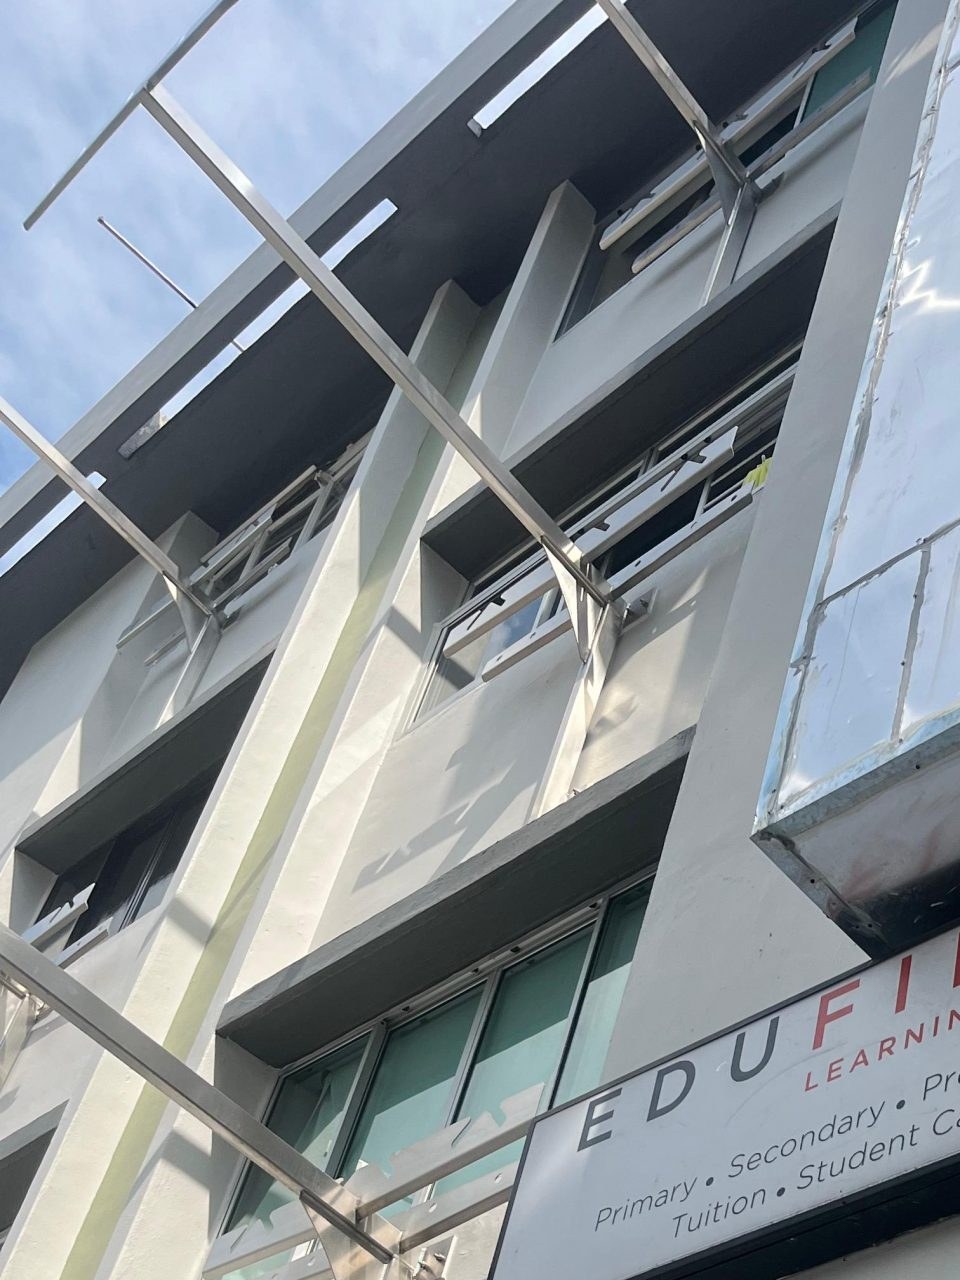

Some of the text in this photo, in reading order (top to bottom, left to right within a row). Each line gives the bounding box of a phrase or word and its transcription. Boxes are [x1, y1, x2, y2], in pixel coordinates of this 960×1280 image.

[594, 1176, 699, 1232] Primary
[727, 1100, 886, 1179] Secondary
[672, 1186, 766, 1239] Tuition
[796, 1126, 919, 1191] Student
